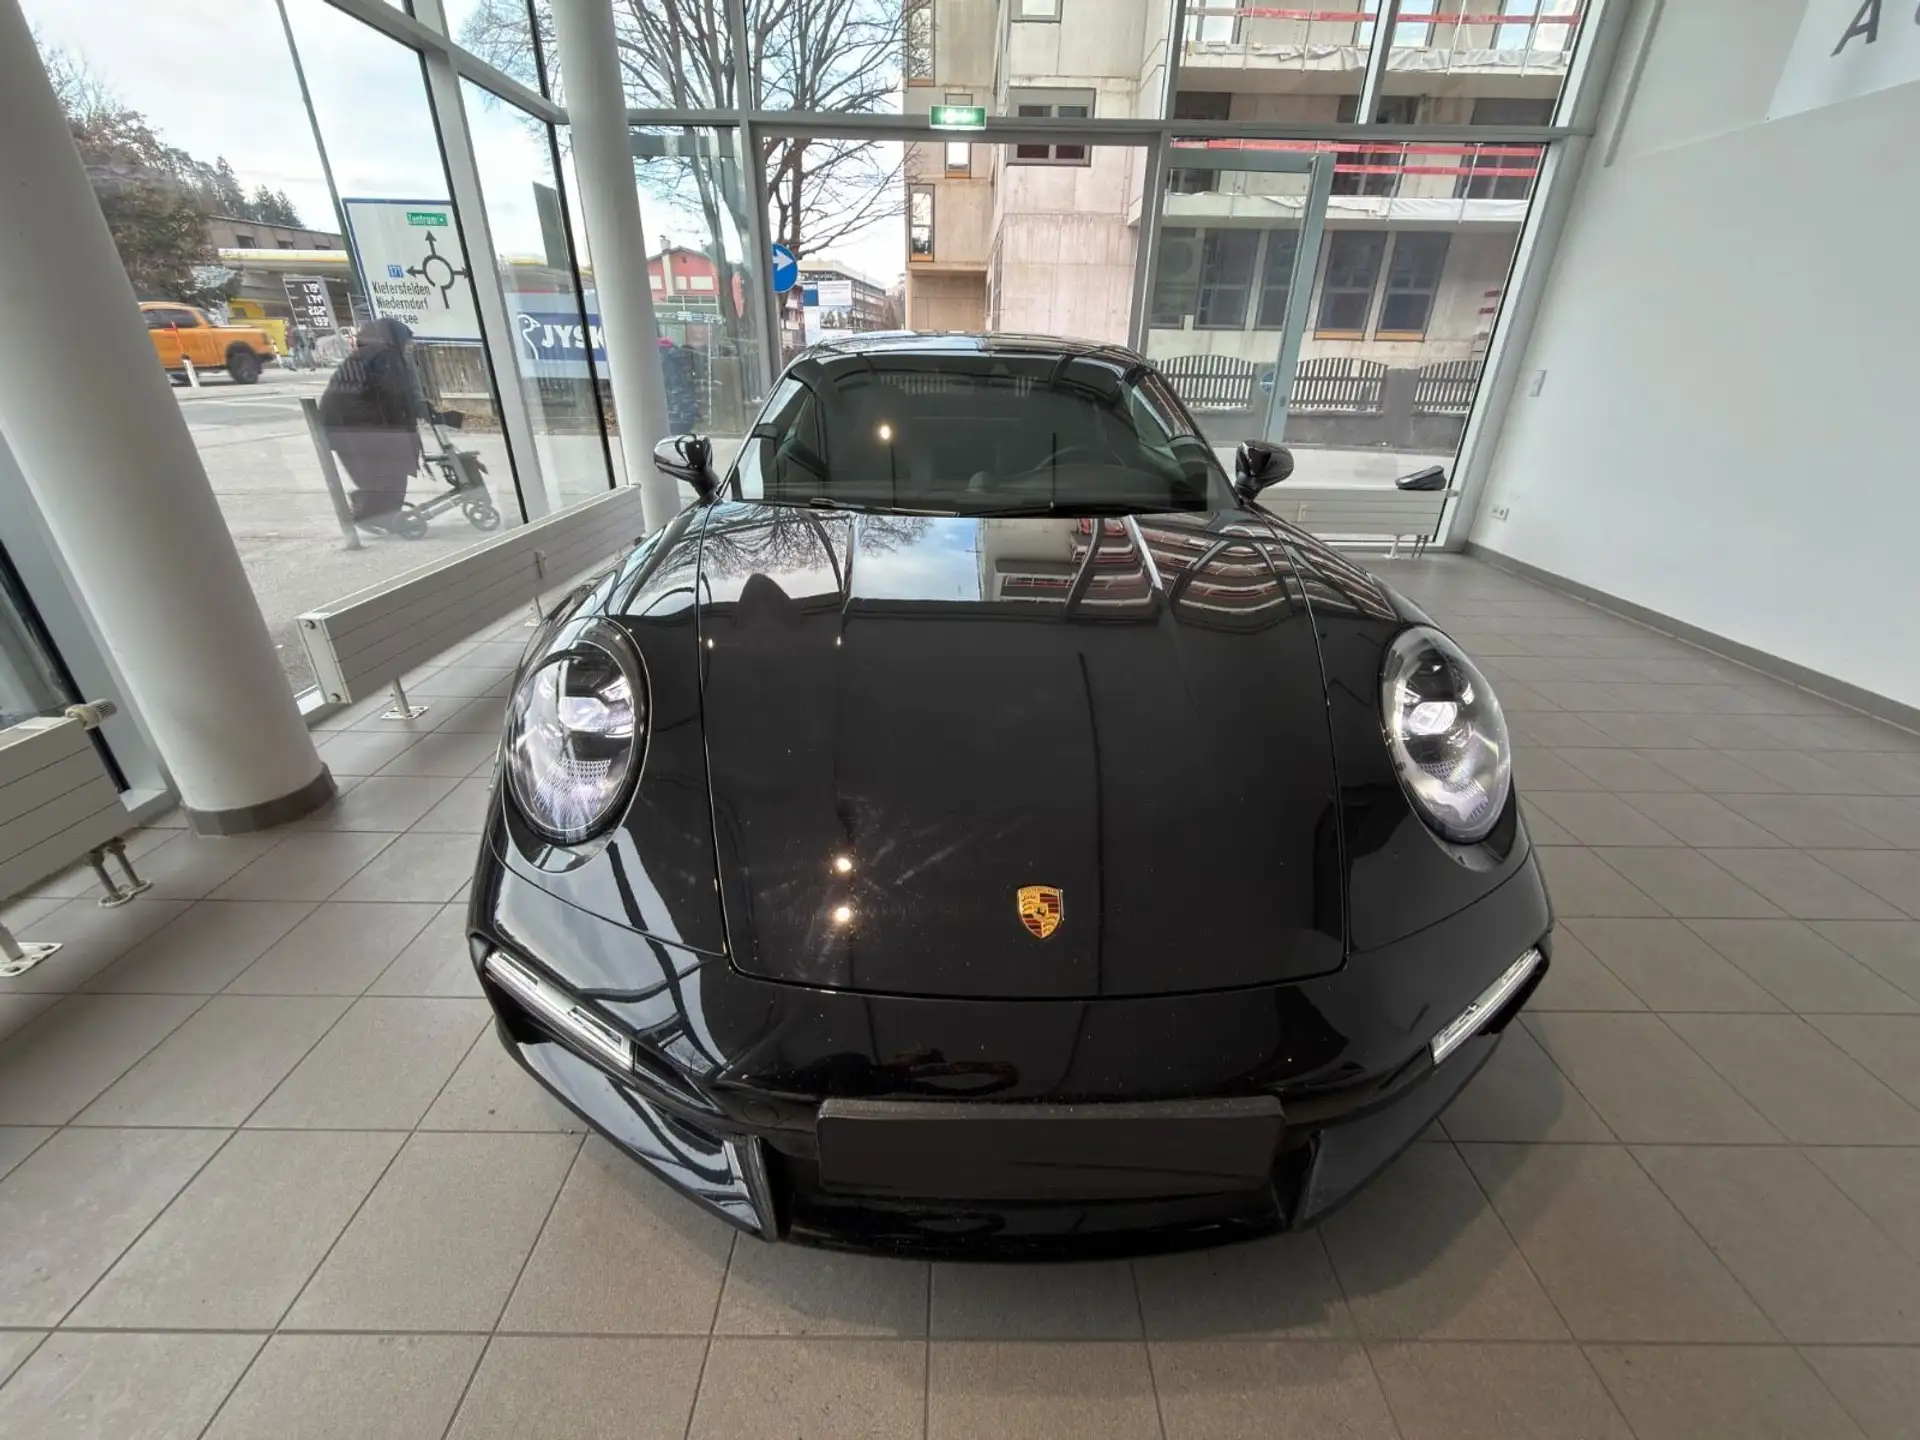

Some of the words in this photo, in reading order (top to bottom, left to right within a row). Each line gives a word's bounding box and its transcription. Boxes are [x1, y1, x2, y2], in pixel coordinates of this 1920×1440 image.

[372, 281, 431, 296] Kiefersfelden
[376, 296, 429, 310] Niederndorf
[541, 324, 604, 349] JYSK
